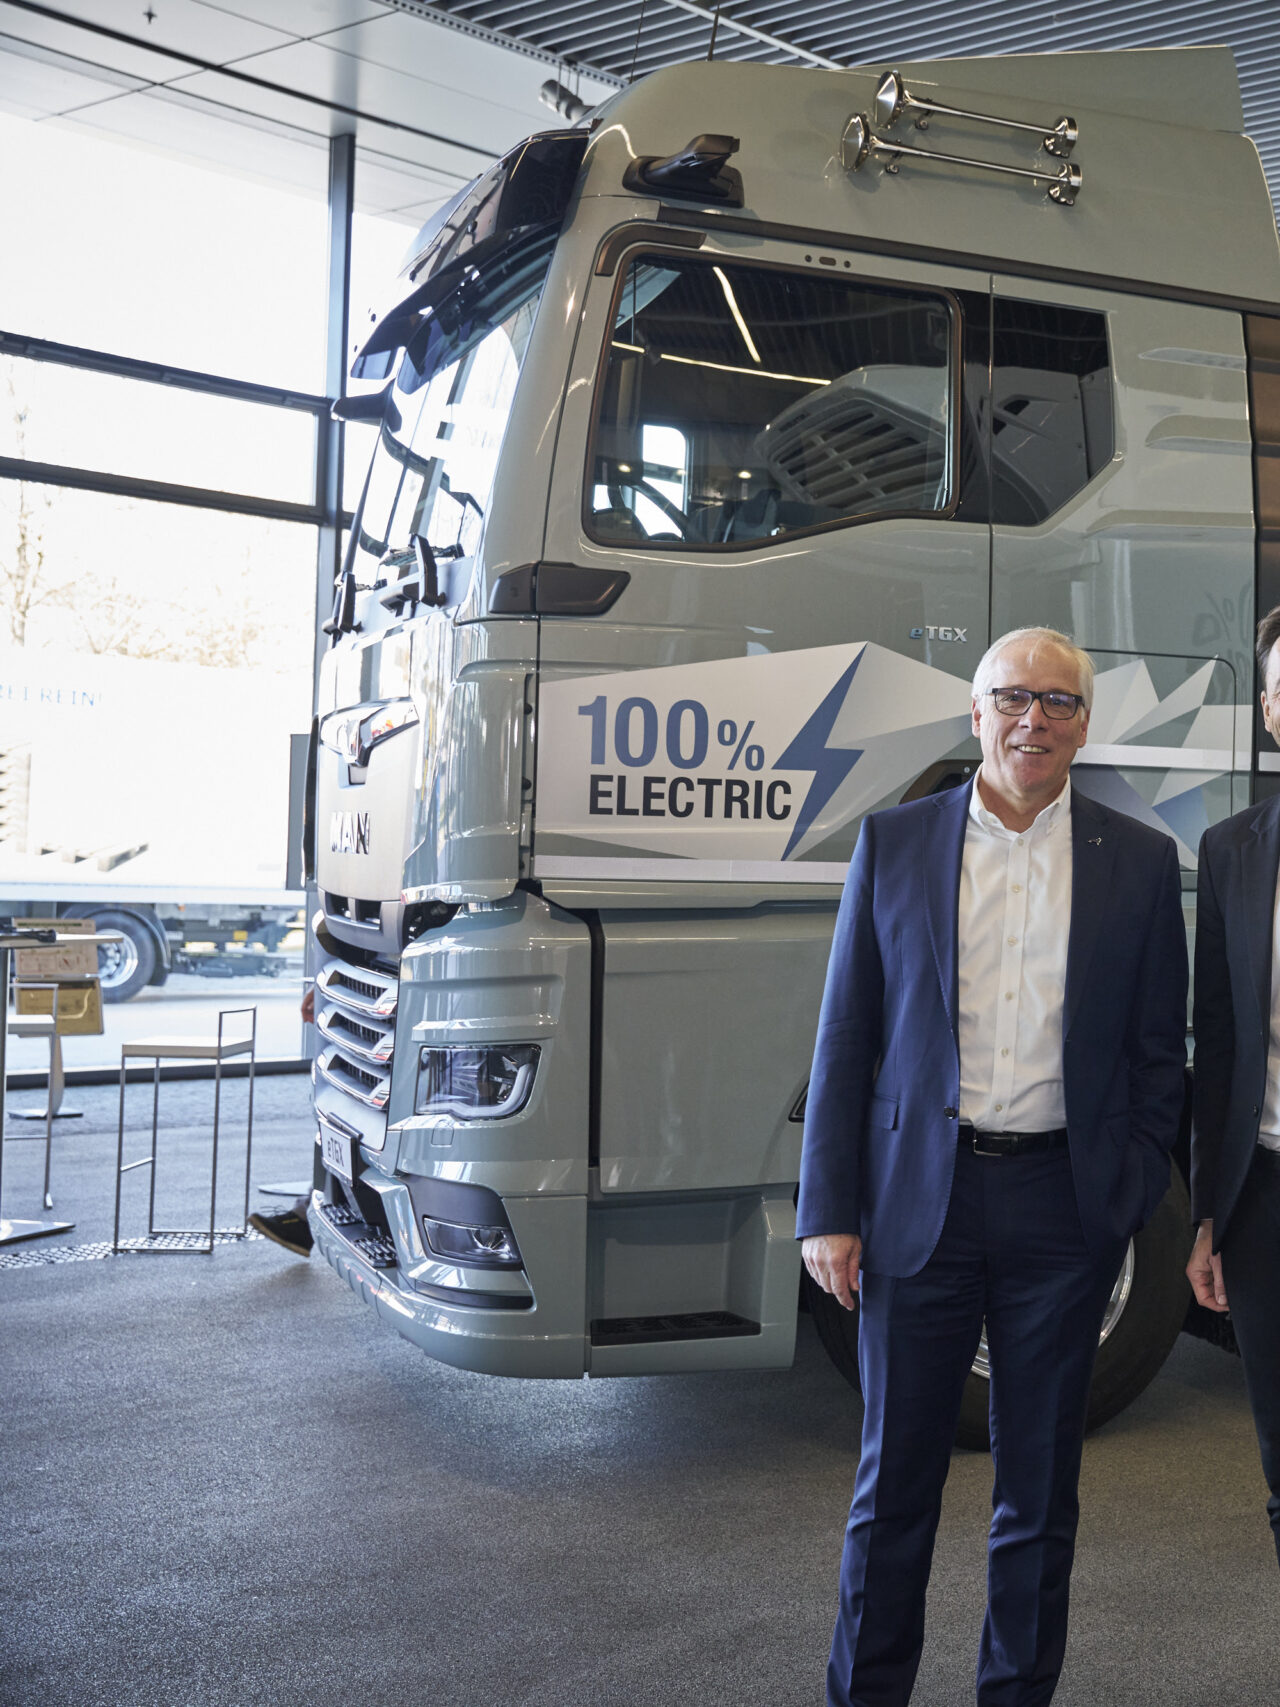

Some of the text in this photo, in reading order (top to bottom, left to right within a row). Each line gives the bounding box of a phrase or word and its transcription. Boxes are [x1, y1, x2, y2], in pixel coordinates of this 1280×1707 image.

[911, 625, 968, 643] eTGX
[578, 695, 765, 771] 100%
[589, 774, 792, 821] ELECTRIC
